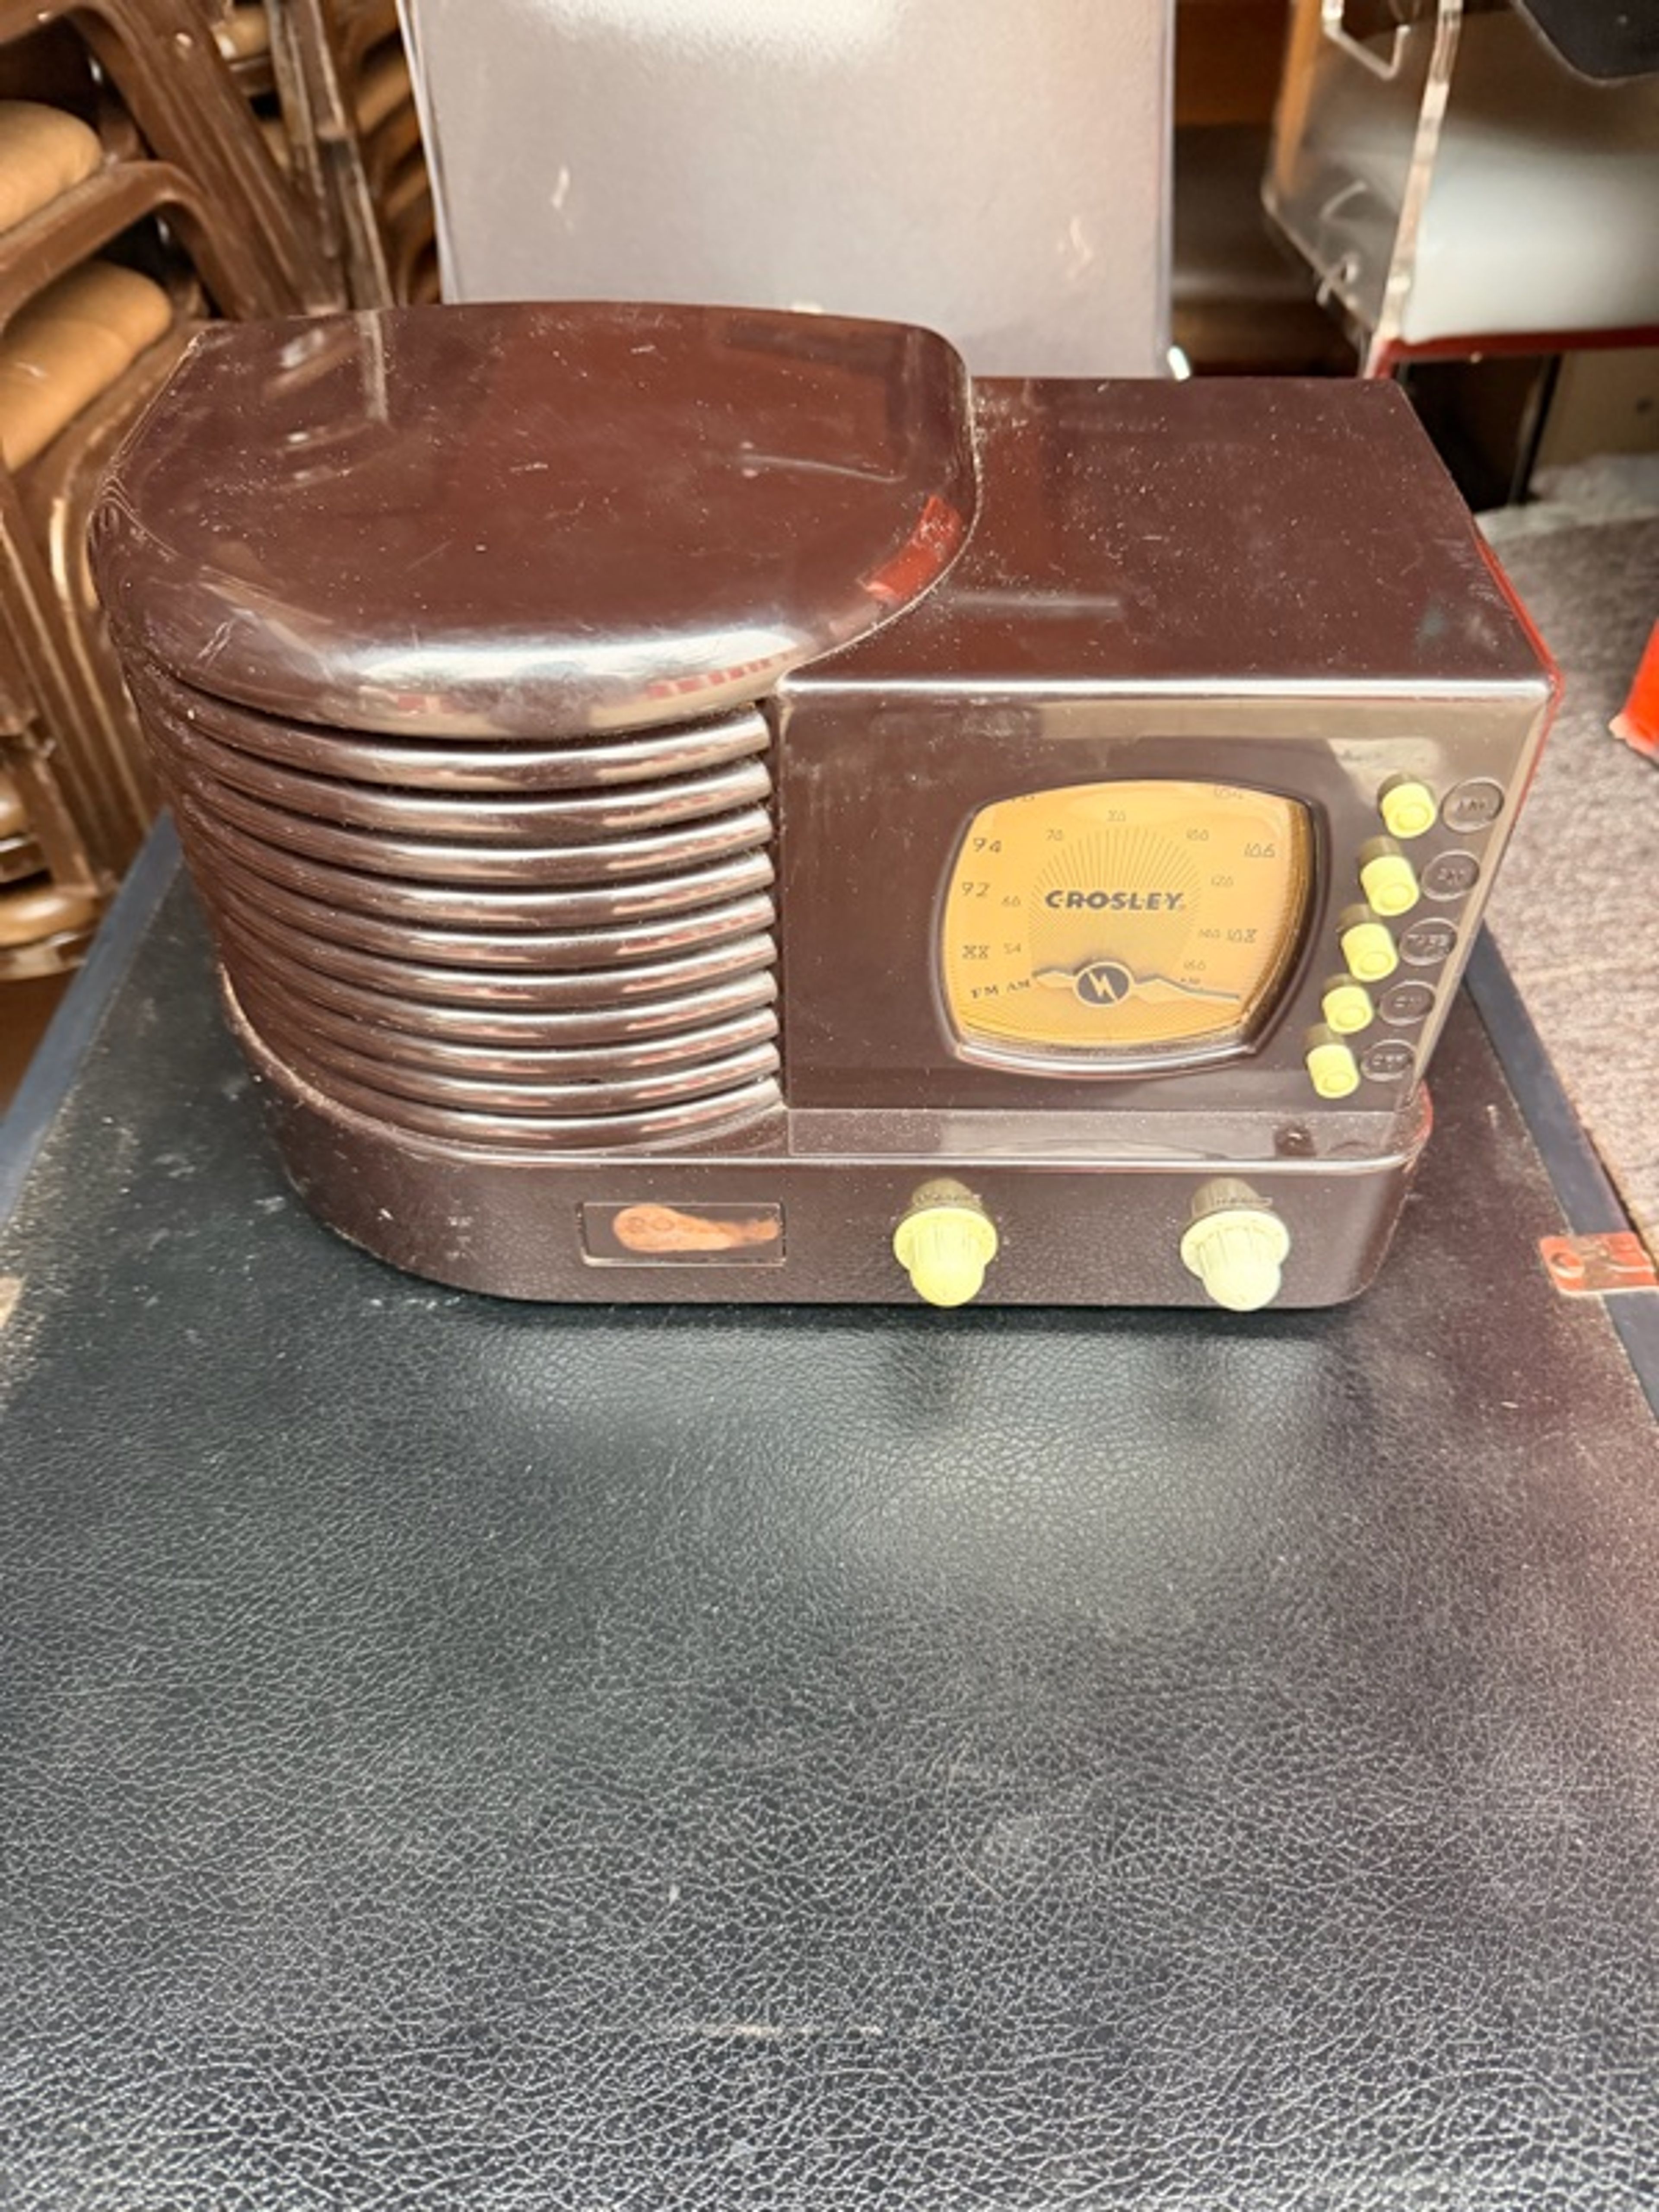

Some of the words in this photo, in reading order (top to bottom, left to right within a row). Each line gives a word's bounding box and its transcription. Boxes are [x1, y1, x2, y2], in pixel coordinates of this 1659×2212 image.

[973, 837, 1001, 853] 94
[1244, 843, 1275, 858] 106
[962, 882, 991, 897] 92
[1045, 890, 1184, 910] CROSLEY
[971, 984, 999, 999] FM
[1006, 979, 1030, 992] AM
